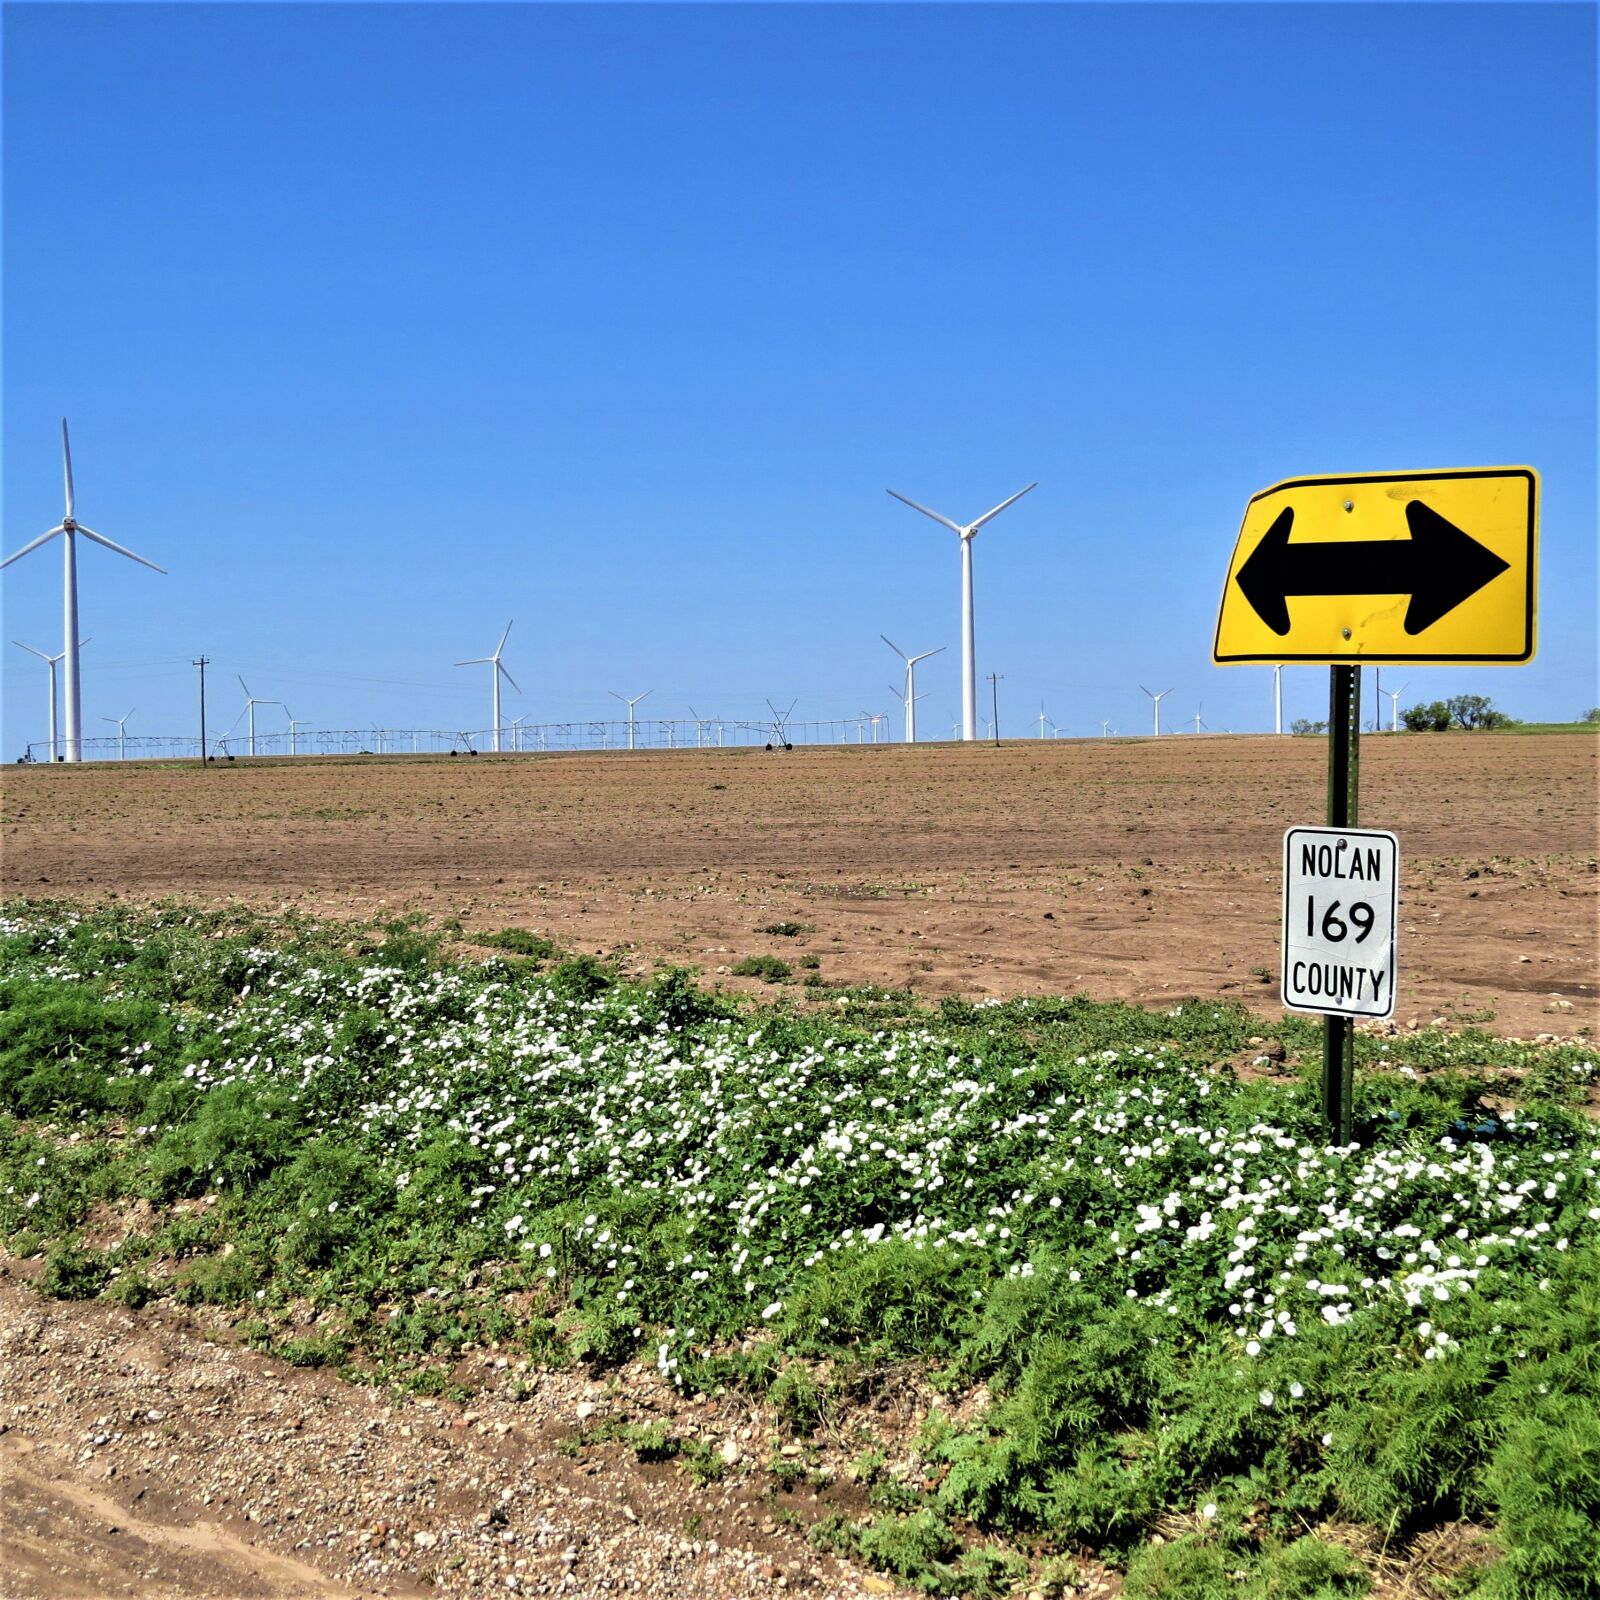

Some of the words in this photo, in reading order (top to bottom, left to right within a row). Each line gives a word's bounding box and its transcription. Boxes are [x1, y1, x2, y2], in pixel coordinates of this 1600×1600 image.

[1302, 844, 1381, 881] NOLAN
[1307, 895, 1375, 944] 169
[1293, 961, 1385, 1002] COUNTY
